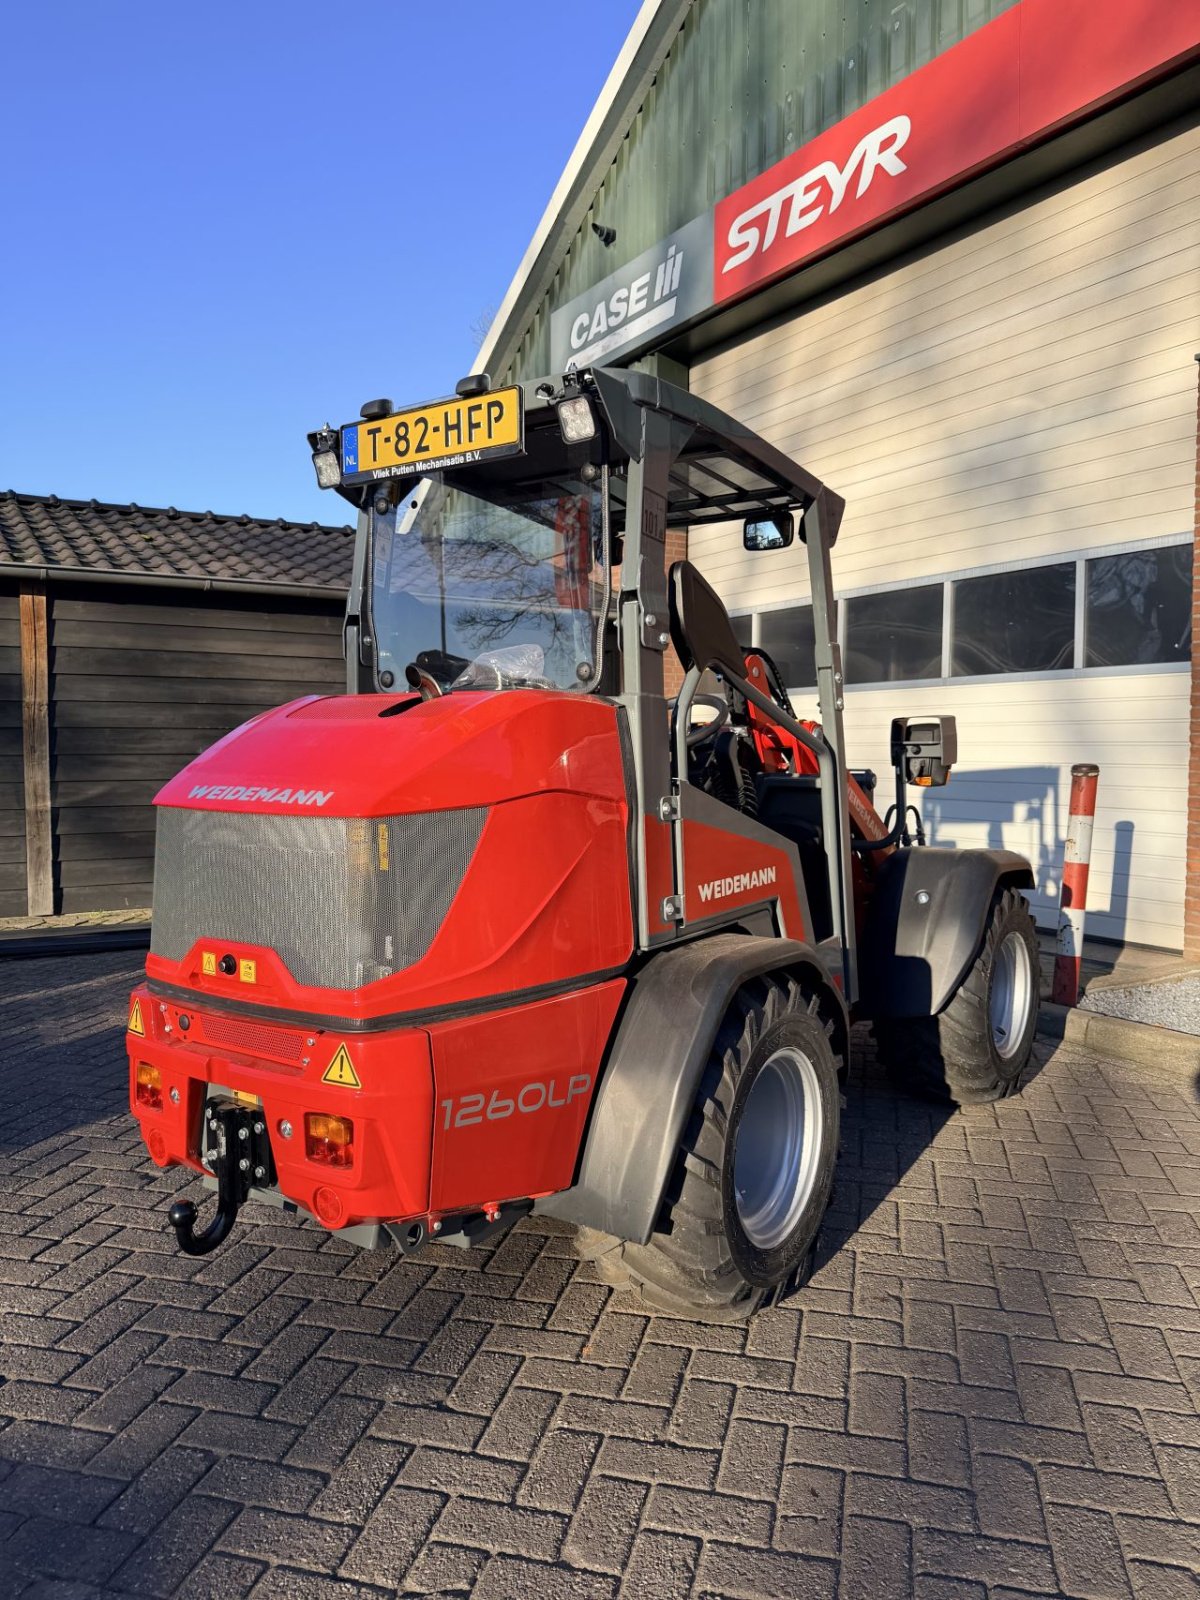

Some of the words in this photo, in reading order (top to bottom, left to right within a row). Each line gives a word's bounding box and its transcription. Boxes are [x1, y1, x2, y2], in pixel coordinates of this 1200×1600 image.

[722, 115, 911, 274] STEYR
[570, 272, 651, 349] CASE
[366, 400, 505, 462] T-82-HFP
[345, 455, 357, 467] NL
[391, 464, 415, 476] Putten
[416, 454, 464, 472] Mechanisatie
[466, 450, 482, 462] B.V.
[188, 785, 335, 807] WEIDEMANN
[847, 786, 883, 841] EIDEMANN
[698, 866, 777, 902] WEIDEMANN
[441, 1073, 592, 1131] 1260LP
